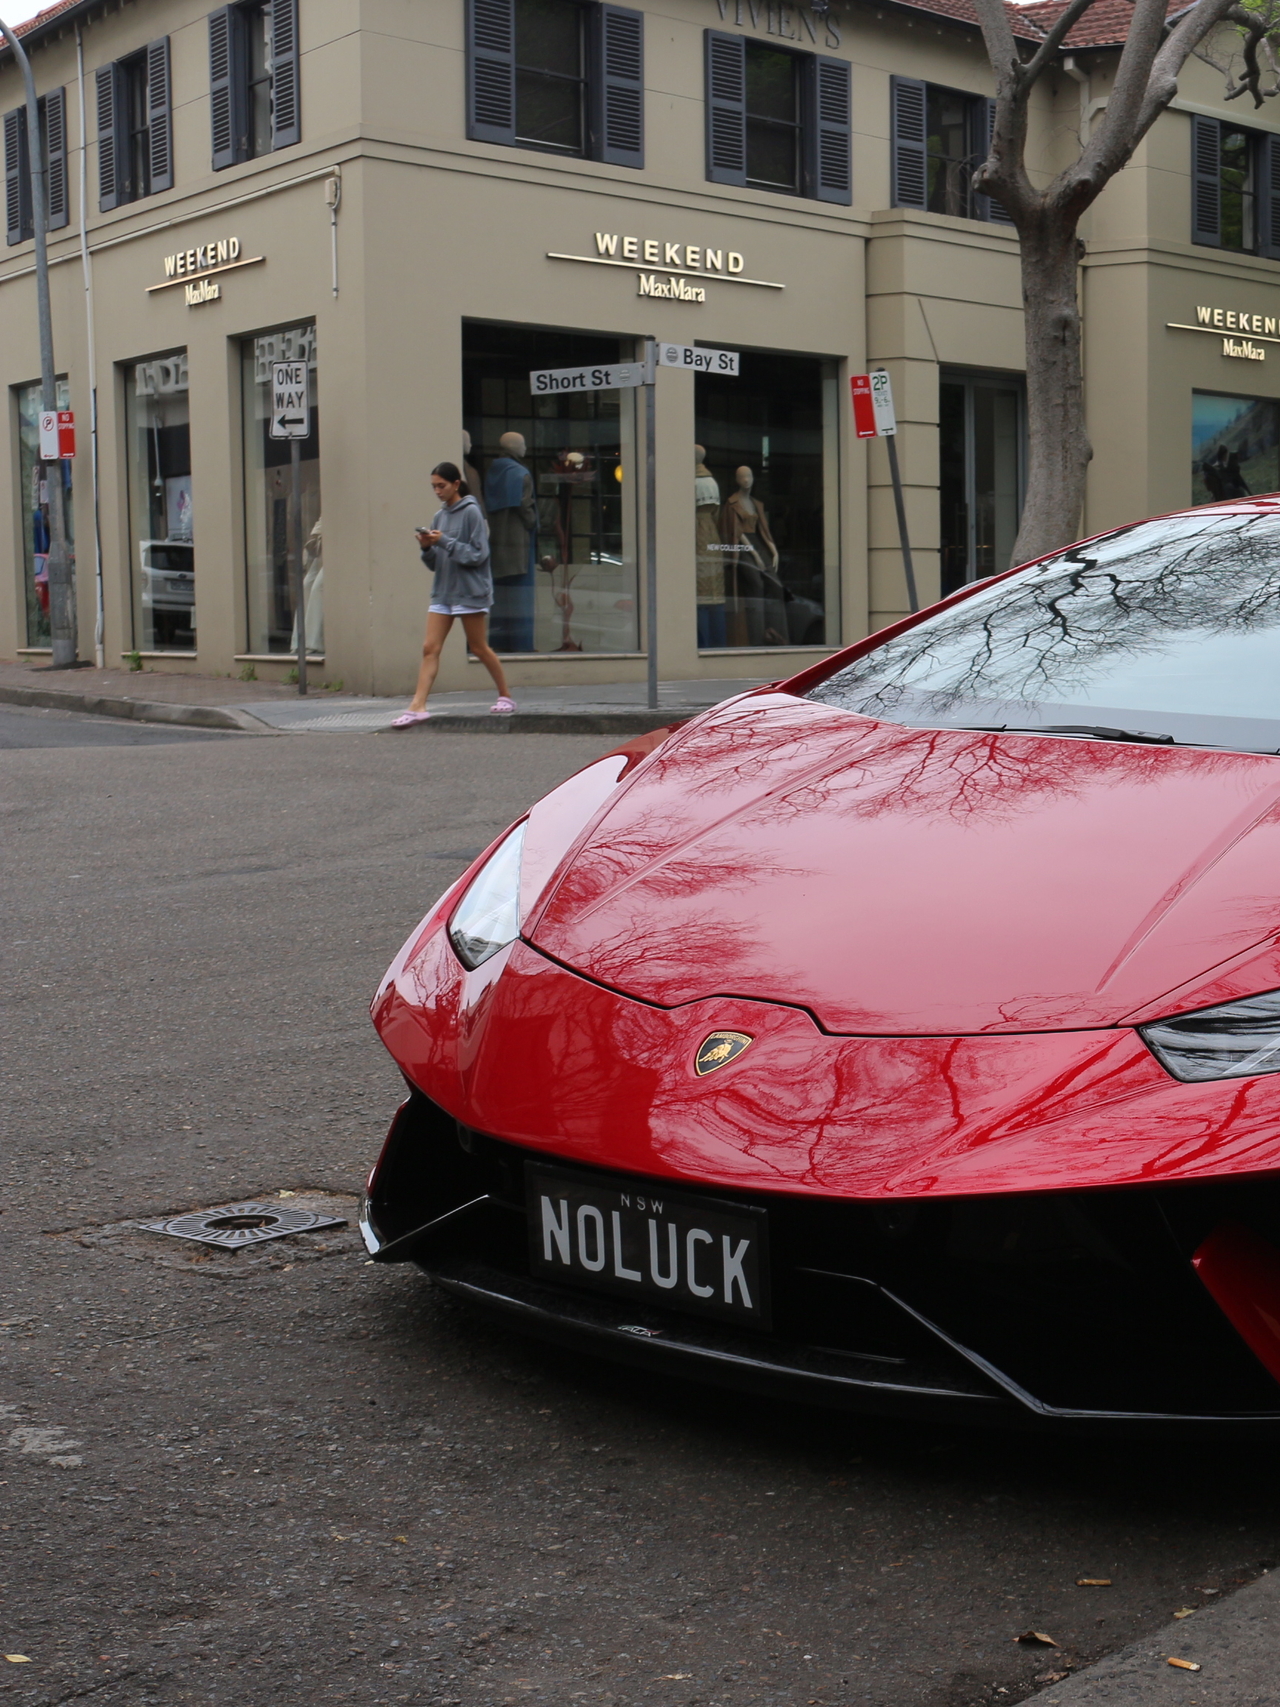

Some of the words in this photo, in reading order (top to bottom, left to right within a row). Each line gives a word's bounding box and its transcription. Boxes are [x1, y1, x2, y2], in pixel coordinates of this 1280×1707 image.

[164, 236, 240, 277] WEEKEND
[595, 232, 745, 274] WEEKEND
[184, 279, 220, 306] MaxMara
[638, 273, 706, 302] MaxMara
[683, 348, 713, 372] Bay
[718, 353, 735, 371] St
[1222, 338, 1265, 360] MaxMara
[277, 368, 302, 386] ONE
[536, 373, 586, 392] Short
[591, 369, 612, 386] St
[872, 375, 888, 391] 2P
[275, 391, 304, 409] WAY
[706, 543, 720, 551] NEW
[720, 544, 754, 552] COLLECTION
[620, 1193, 663, 1214] NSW
[540, 1195, 753, 1309] NOLUCK
